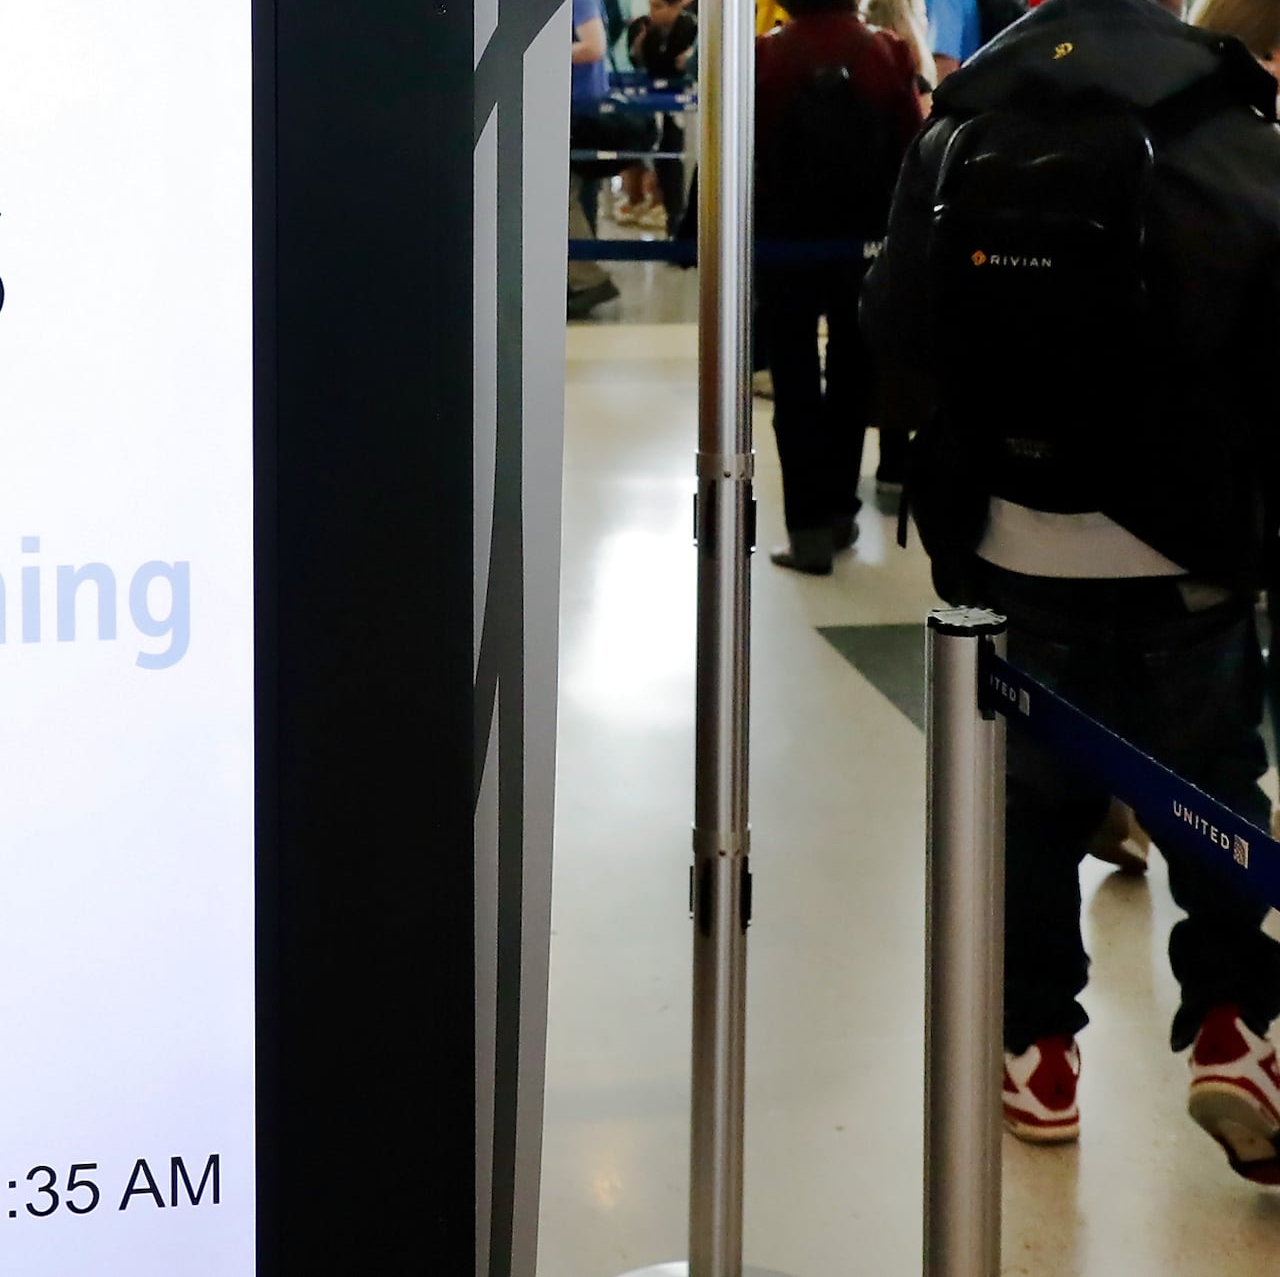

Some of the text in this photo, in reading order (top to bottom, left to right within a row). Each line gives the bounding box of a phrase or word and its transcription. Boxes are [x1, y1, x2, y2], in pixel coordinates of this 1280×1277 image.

[990, 254, 1051, 267] RIVIAN
[1173, 799, 1229, 850] UNITED
[119, 1154, 219, 1210] AM
